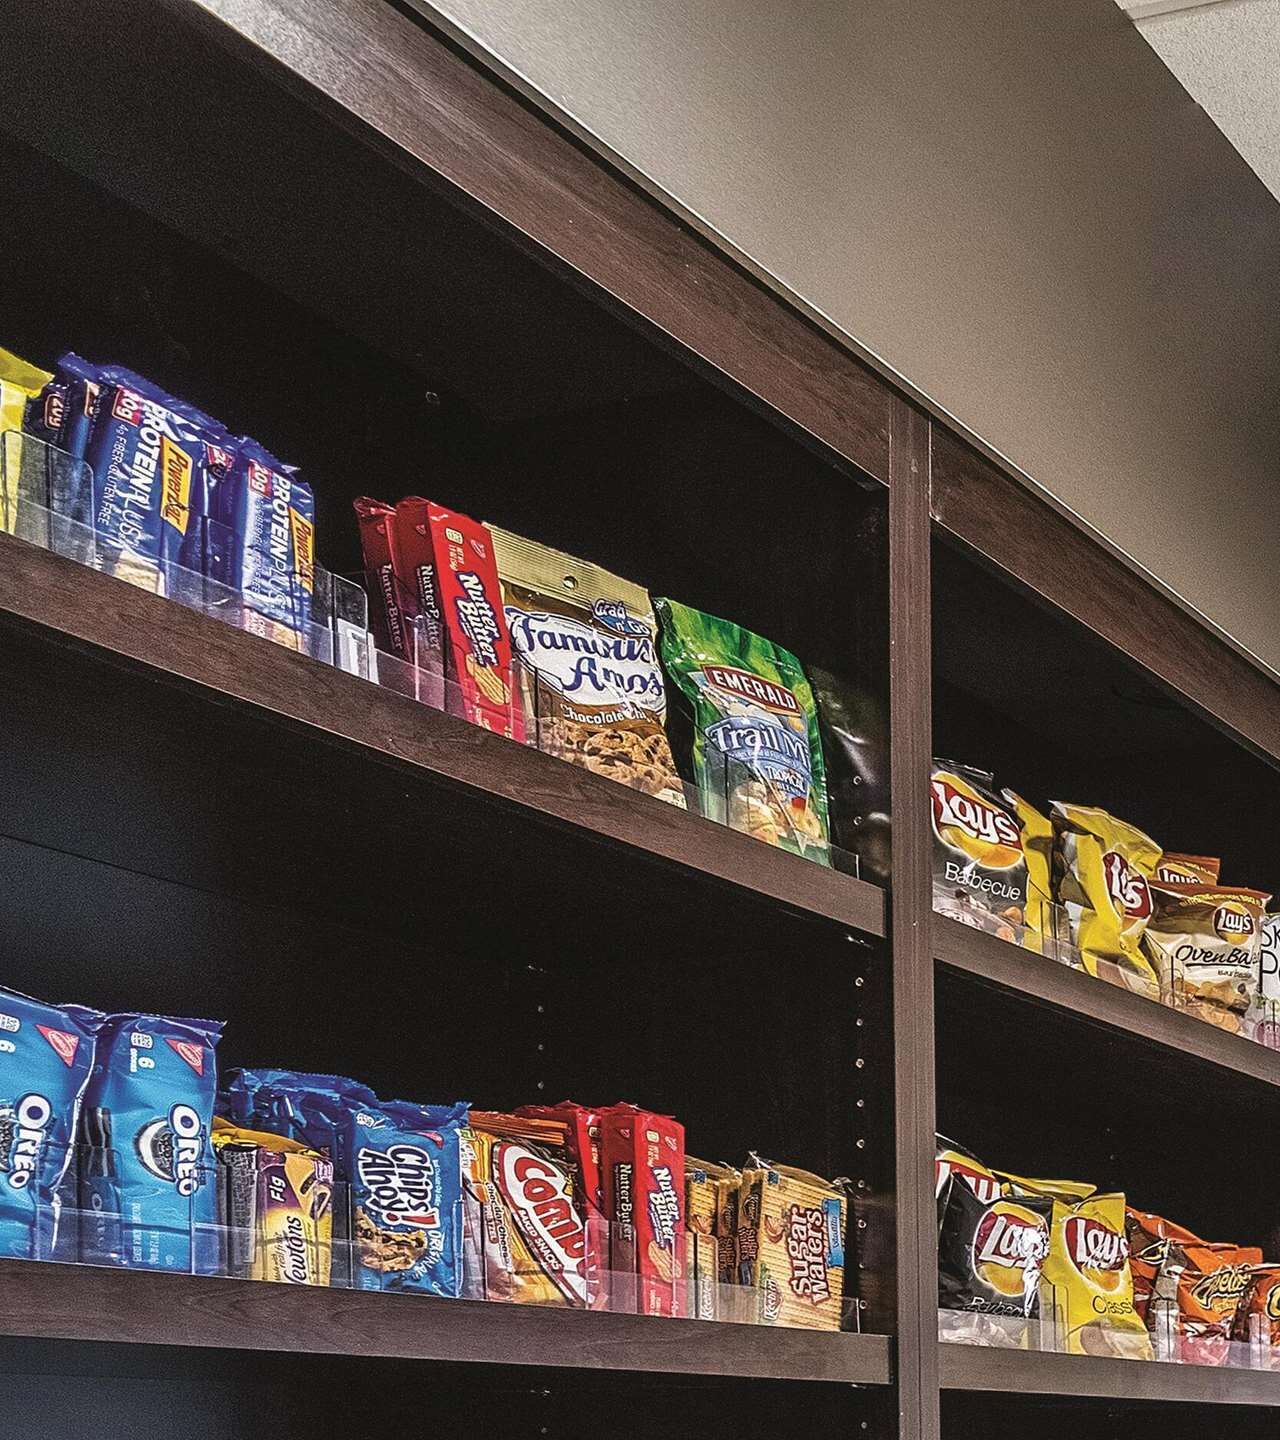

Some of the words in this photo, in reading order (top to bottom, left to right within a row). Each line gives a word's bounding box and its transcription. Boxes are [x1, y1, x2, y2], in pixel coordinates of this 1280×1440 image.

[459, 574, 500, 639] Nutter
[456, 599, 499, 667] Butter
[505, 605, 655, 663] Famous
[561, 656, 665, 697] Amos
[713, 670, 798, 712] EMERALD
[560, 703, 624, 725] Chocolate
[710, 724, 781, 753] Trail
[932, 779, 1021, 845] Lay's
[943, 861, 1022, 901] Barbecue
[1216, 908, 1253, 933] Lay's
[1175, 945, 1232, 964] Oven
[8, 1092, 52, 1189] OREO
[166, 1103, 203, 1197] OREO
[269, 1175, 287, 1202] Fig
[387, 1145, 436, 1220] Chips
[619, 1164, 633, 1203] Nutter
[653, 1168, 681, 1220] Nutter
[519, 1210, 538, 1238] BAKED
[535, 1236, 564, 1272] SNACKS
[649, 1188, 676, 1242] Butter
[788, 1203, 812, 1296] Sugar
[803, 1209, 830, 1304] Wafers
[1076, 1217, 1130, 1269] Lay's
[1091, 1294, 1134, 1314] Classi
